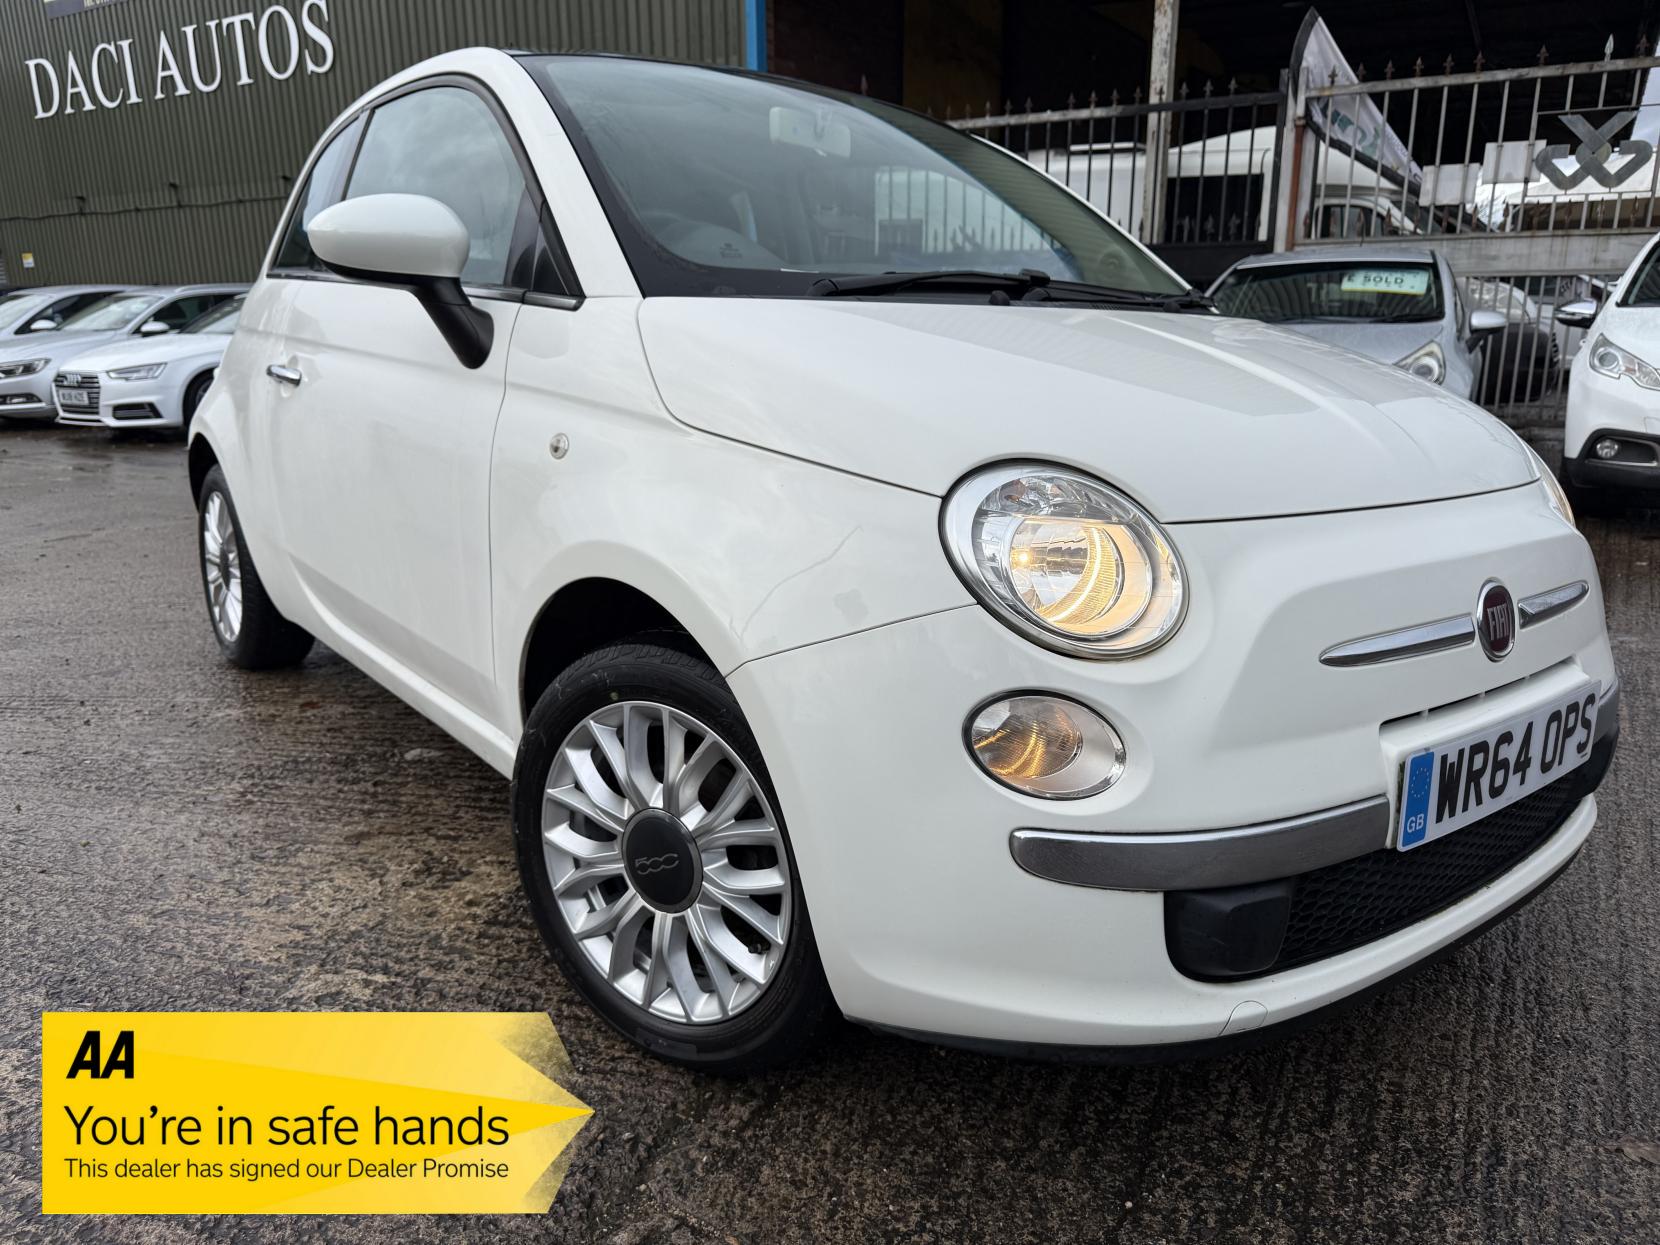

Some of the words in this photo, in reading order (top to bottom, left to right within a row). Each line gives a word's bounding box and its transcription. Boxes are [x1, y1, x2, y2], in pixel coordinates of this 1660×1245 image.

[25, 39, 143, 119] DACI
[154, 0, 334, 99] AUTOS
[1487, 603, 1509, 641] FIAT
[1435, 721, 1534, 824] WR64
[1541, 693, 1596, 774] OPS
[1407, 813, 1425, 833] GB
[635, 853, 679, 875] 500
